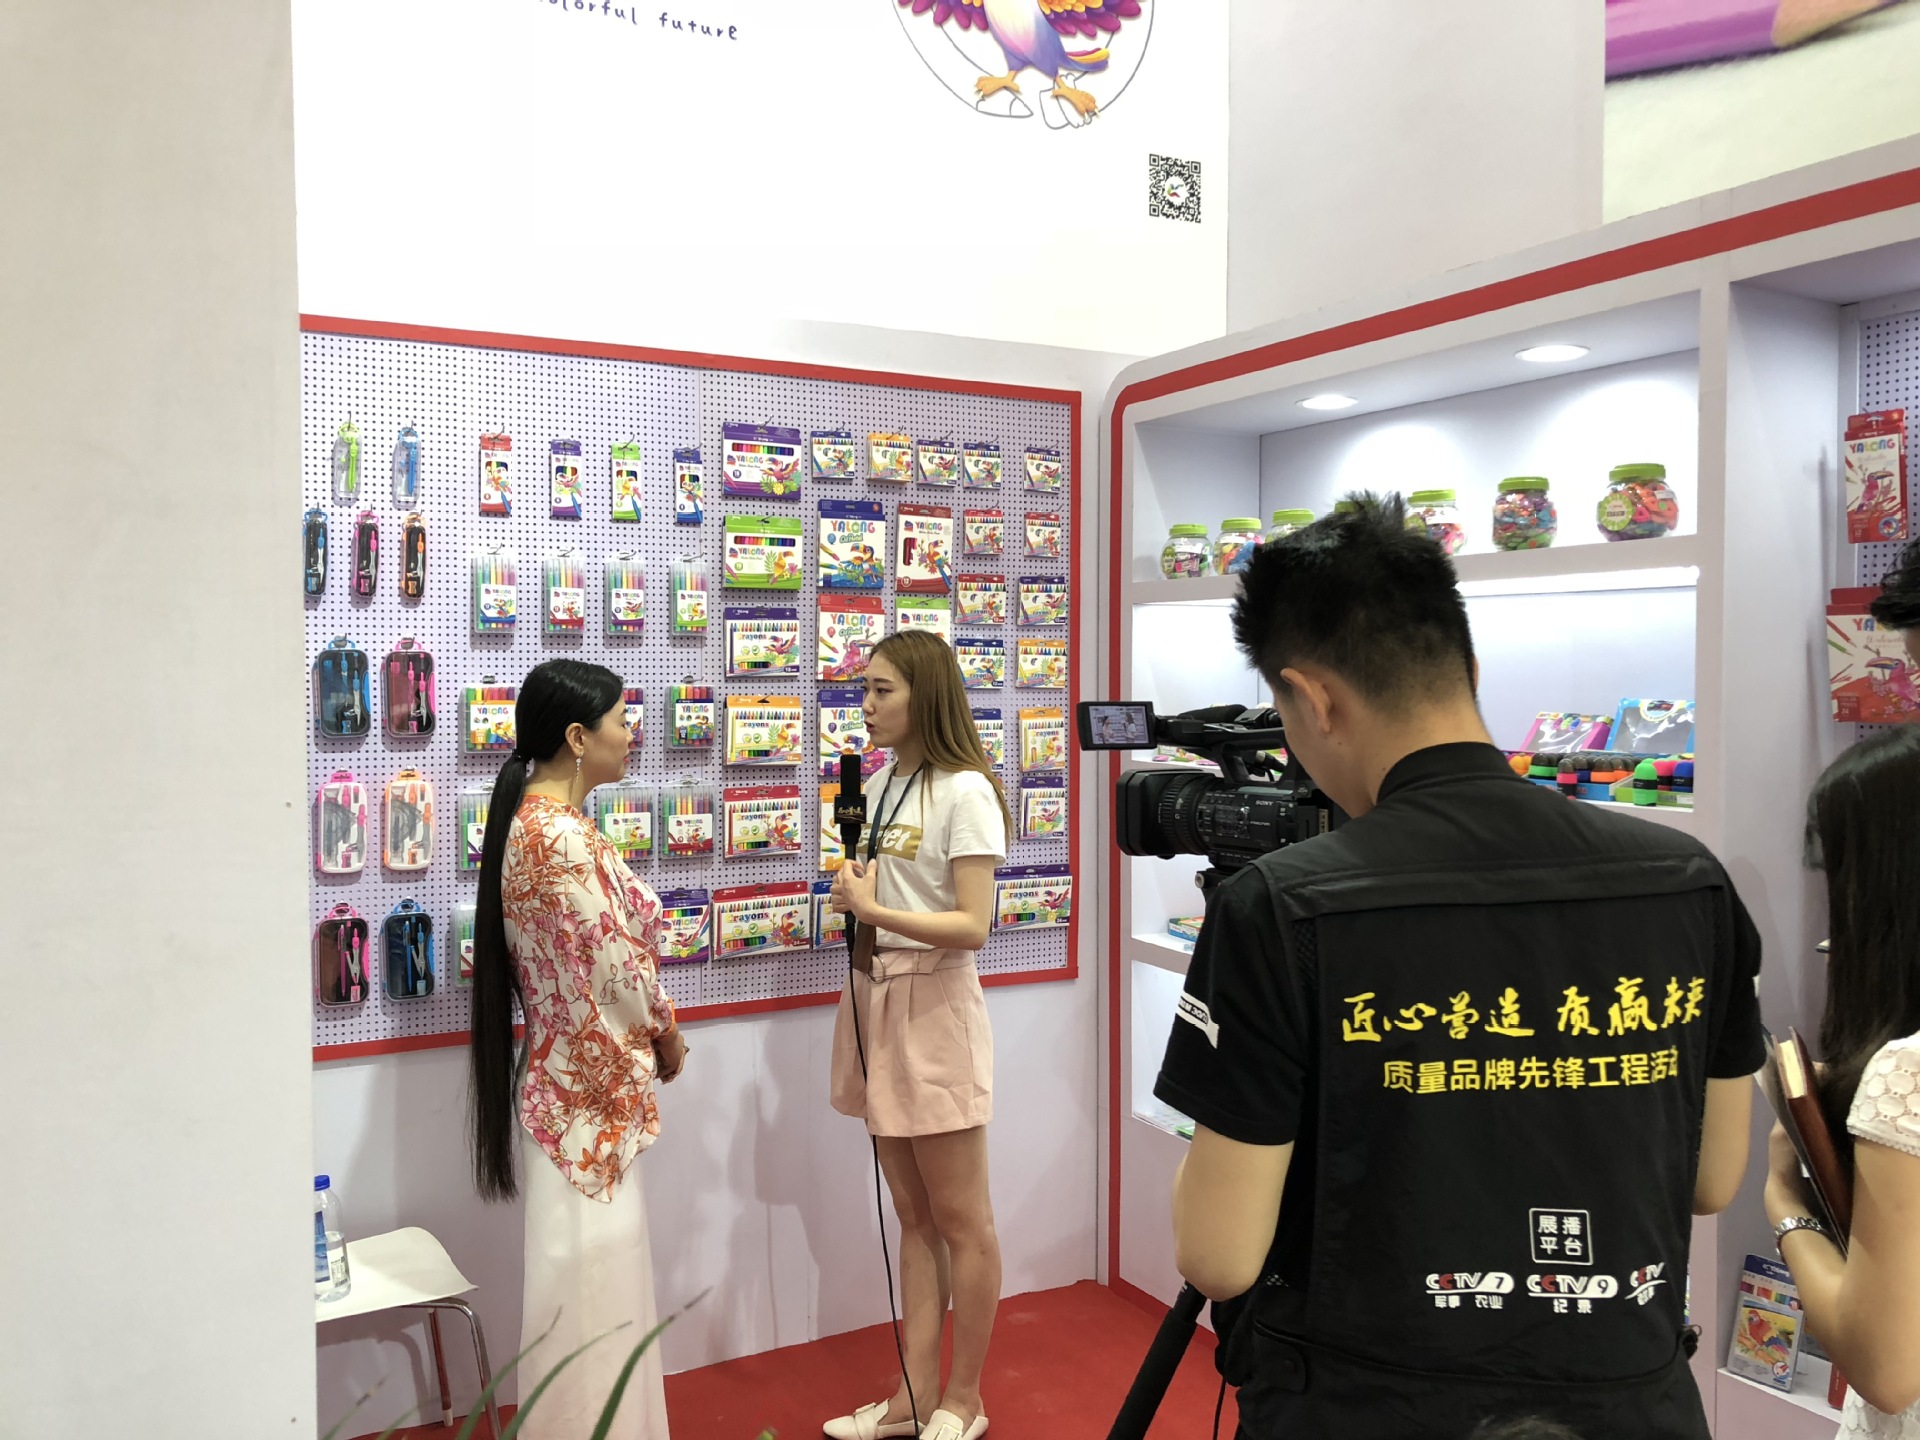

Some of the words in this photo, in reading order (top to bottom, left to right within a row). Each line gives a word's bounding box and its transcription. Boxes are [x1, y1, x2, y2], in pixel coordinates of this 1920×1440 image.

[539, 0, 637, 25] lorful
[659, 12, 738, 40] future
[1849, 438, 1896, 454] YALONG
[736, 455, 763, 464] YALONG
[831, 520, 875, 533] YALONG
[915, 521, 943, 531] YALONG
[738, 547, 765, 555] YALONG
[830, 613, 875, 627] YALONG
[912, 613, 939, 622] YALONG
[736, 633, 767, 641] Crayons
[477, 707, 509, 715] YALONG
[682, 705, 709, 713] YALONG
[831, 709, 864, 721] YALO
[1031, 800, 1060, 808] Crayons
[735, 813, 767, 821] Crayons
[1002, 890, 1039, 900] Crayons
[672, 917, 699, 926] YALONG
[725, 911, 770, 924] Crayons
[1538, 1215, 1582, 1235] 展播
[1540, 1236, 1583, 1256] 平台
[1630, 1262, 1665, 1287] CCTV
